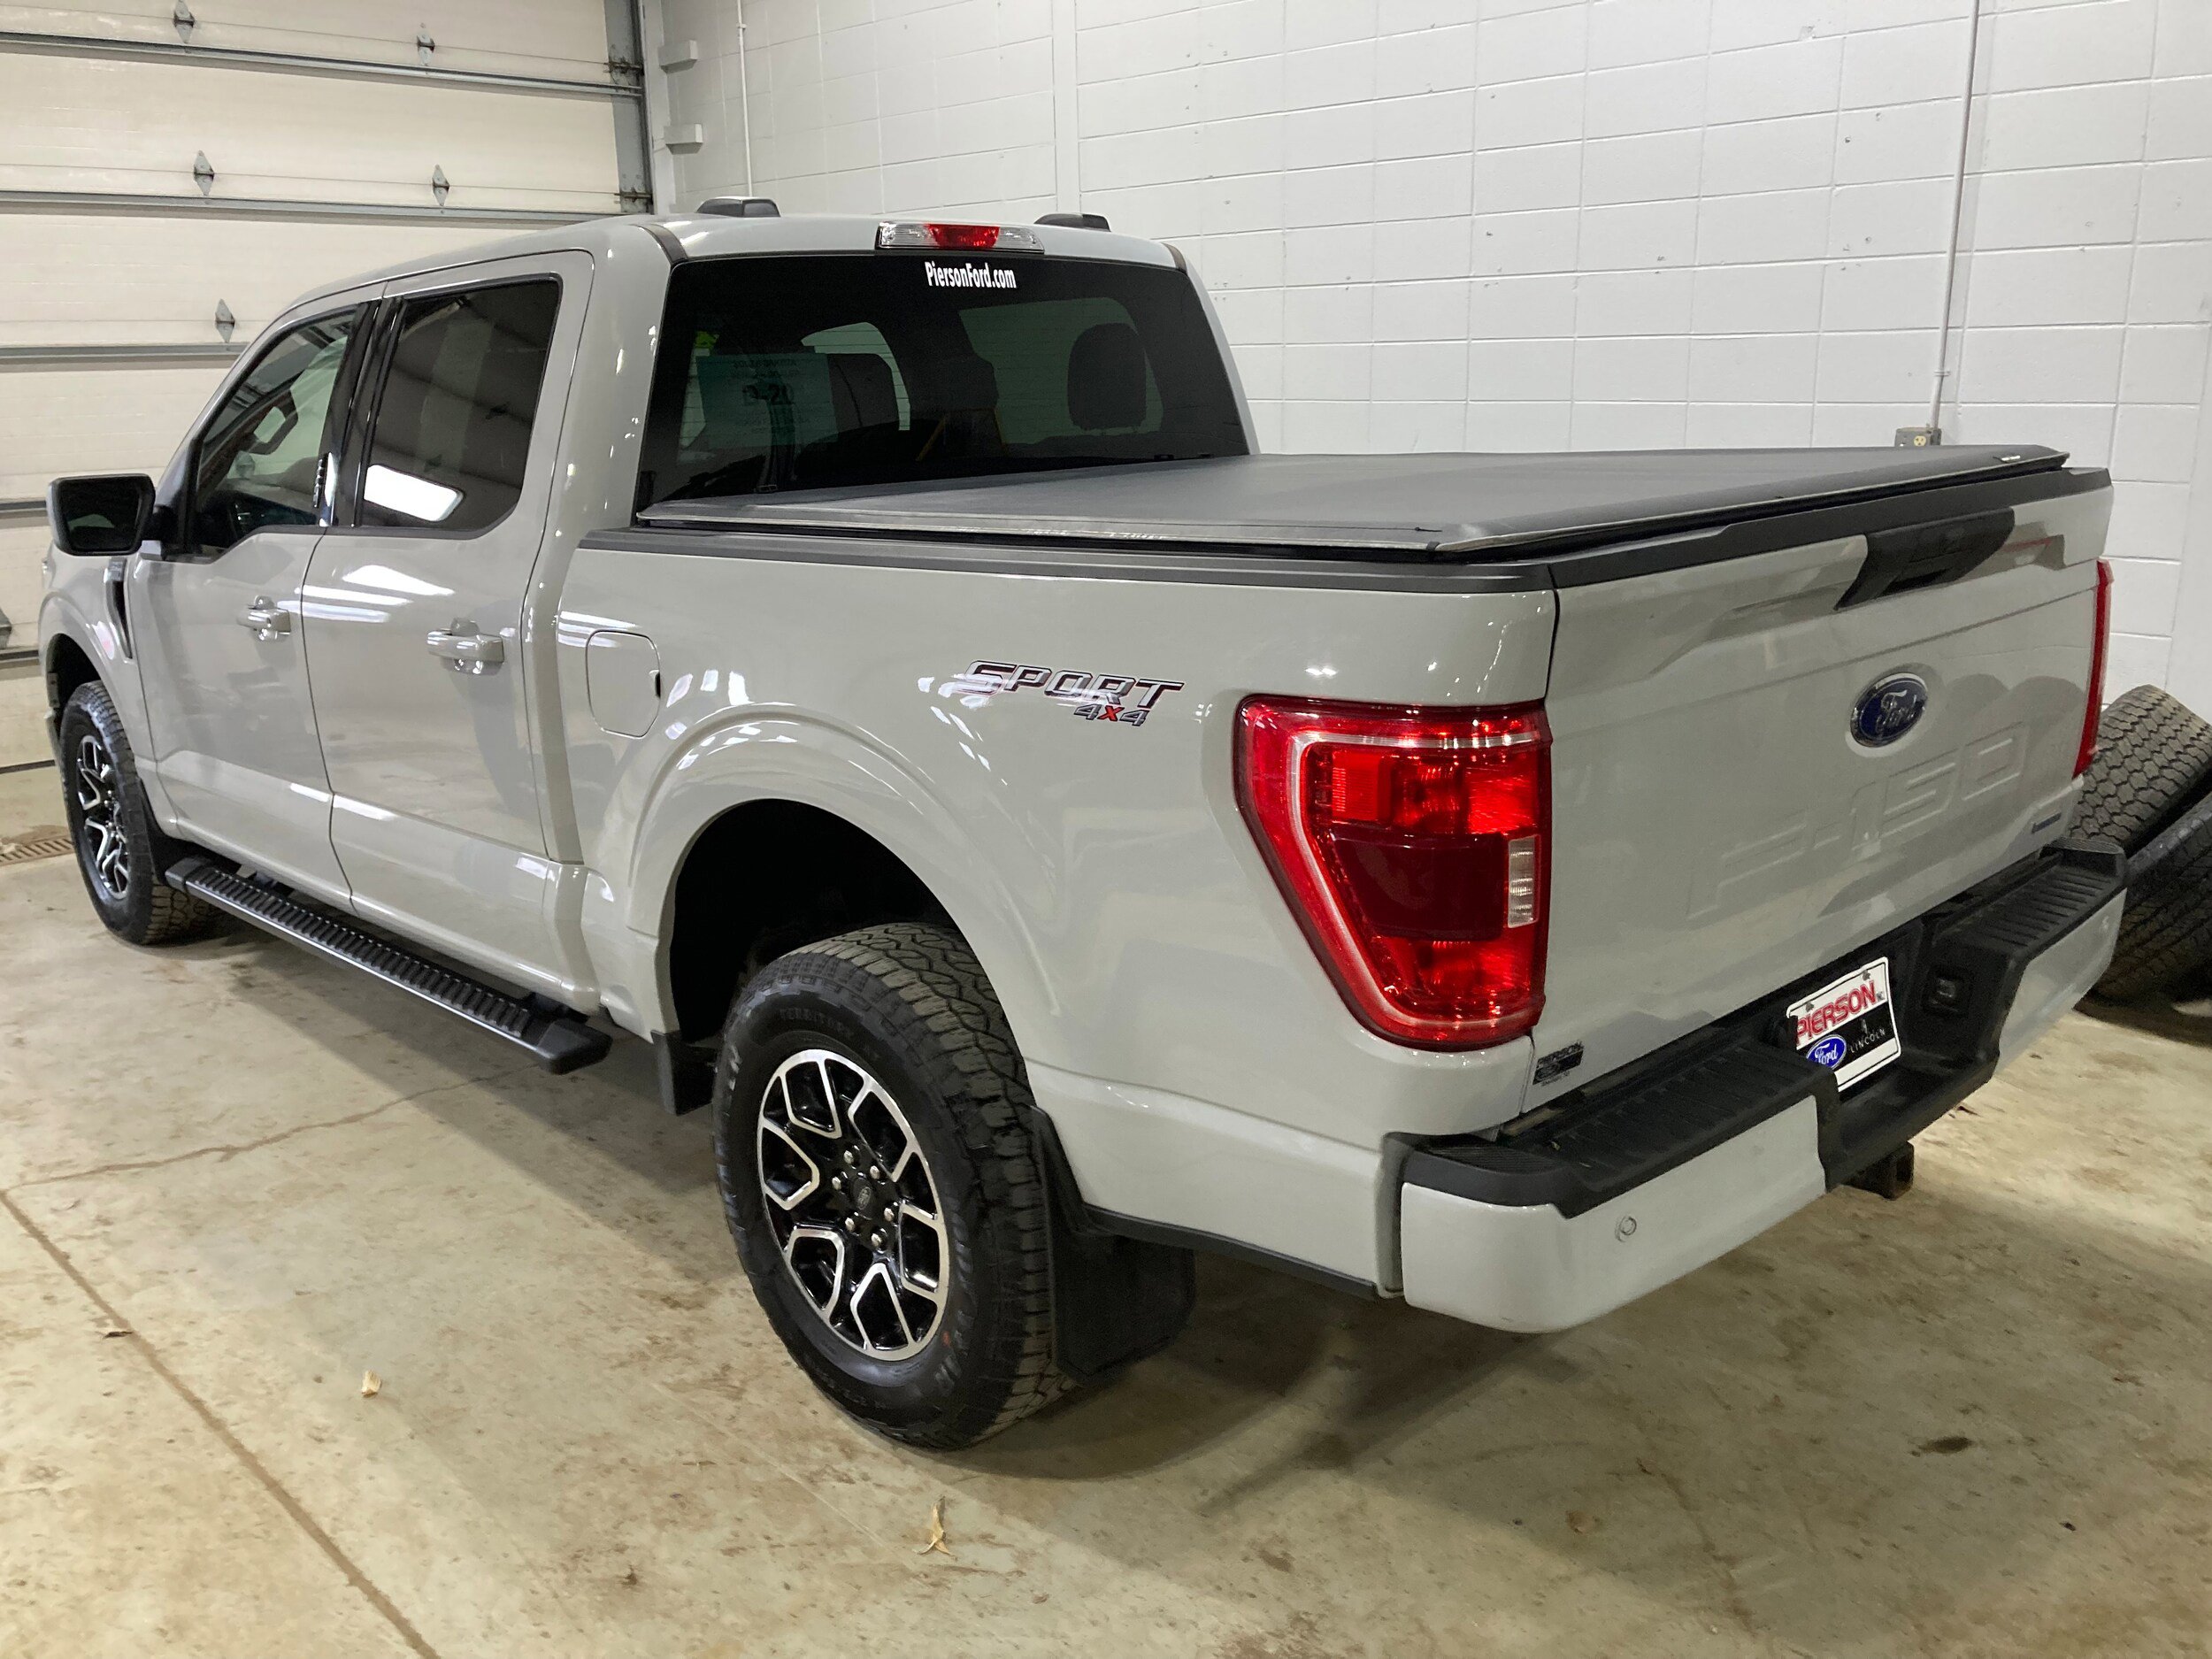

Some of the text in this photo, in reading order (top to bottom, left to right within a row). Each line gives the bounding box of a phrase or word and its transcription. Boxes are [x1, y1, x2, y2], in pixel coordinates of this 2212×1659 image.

[924, 261, 1018, 288] PiersonFord.com
[958, 658, 1186, 710] SPORT
[1875, 689, 1916, 733] Ford
[1686, 721, 2028, 920] F-150
[1796, 980, 1877, 1046] PIERSON
[1814, 1042, 1839, 1065] Ford
[1849, 1027, 1886, 1053] LINCOLN
